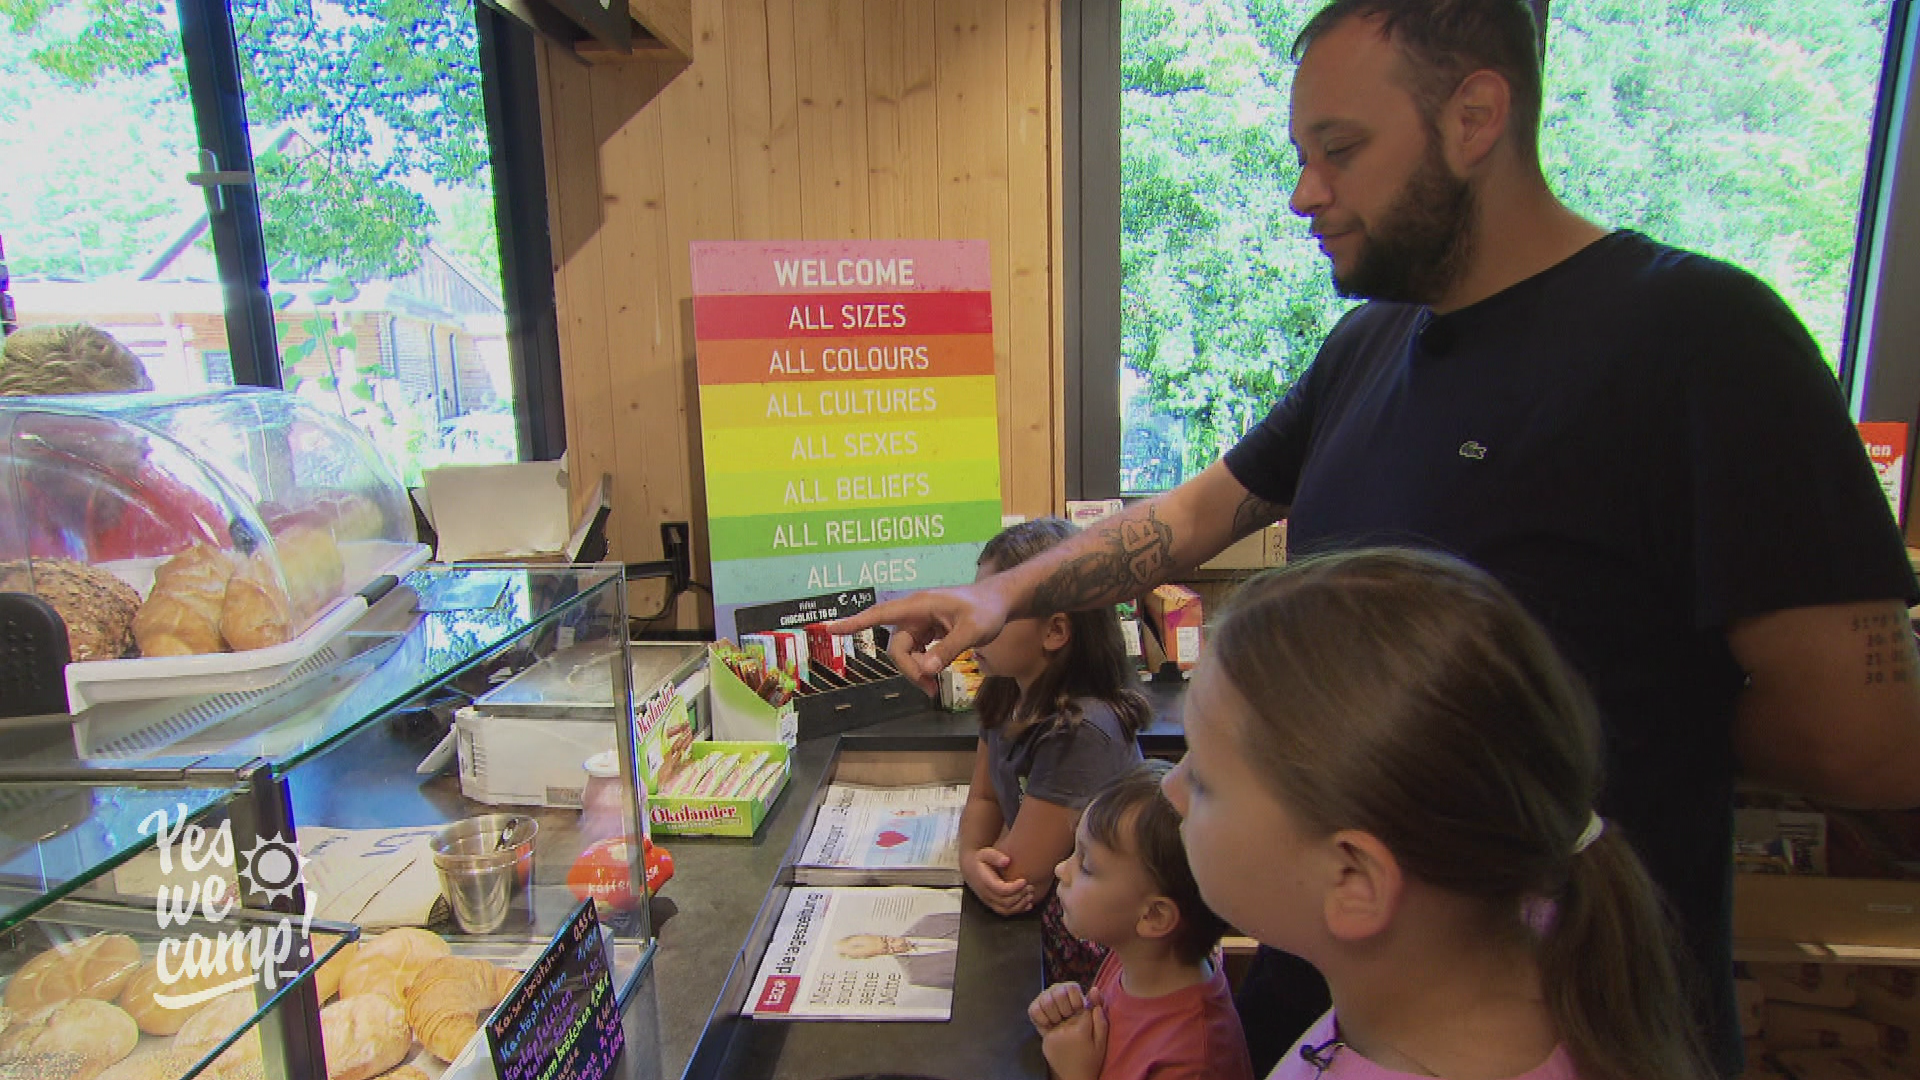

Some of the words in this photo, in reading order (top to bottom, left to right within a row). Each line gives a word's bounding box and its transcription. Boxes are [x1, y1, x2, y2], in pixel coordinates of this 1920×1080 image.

[773, 258, 915, 288] WELCOME
[788, 305, 834, 330] ALL
[841, 303, 907, 329] SIZES
[769, 349, 815, 374] ALL
[822, 346, 930, 372] COLOURS
[766, 392, 812, 418] ALL
[819, 388, 937, 416] CULTURES
[791, 436, 836, 461] ALL
[844, 431, 918, 458] SEXES
[784, 480, 828, 505] ALL
[836, 473, 931, 501] BELIEFS
[772, 523, 818, 549] ALL
[825, 515, 945, 546] RELIGIONS
[806, 564, 851, 589] ALL
[858, 558, 918, 584] AGES
[780, 610, 818, 626] CHOCOLATE
[818, 608, 828, 620] TO
[828, 606, 838, 619] GO
[776, 956, 796, 974] die
[859, 972, 880, 1006] seine
